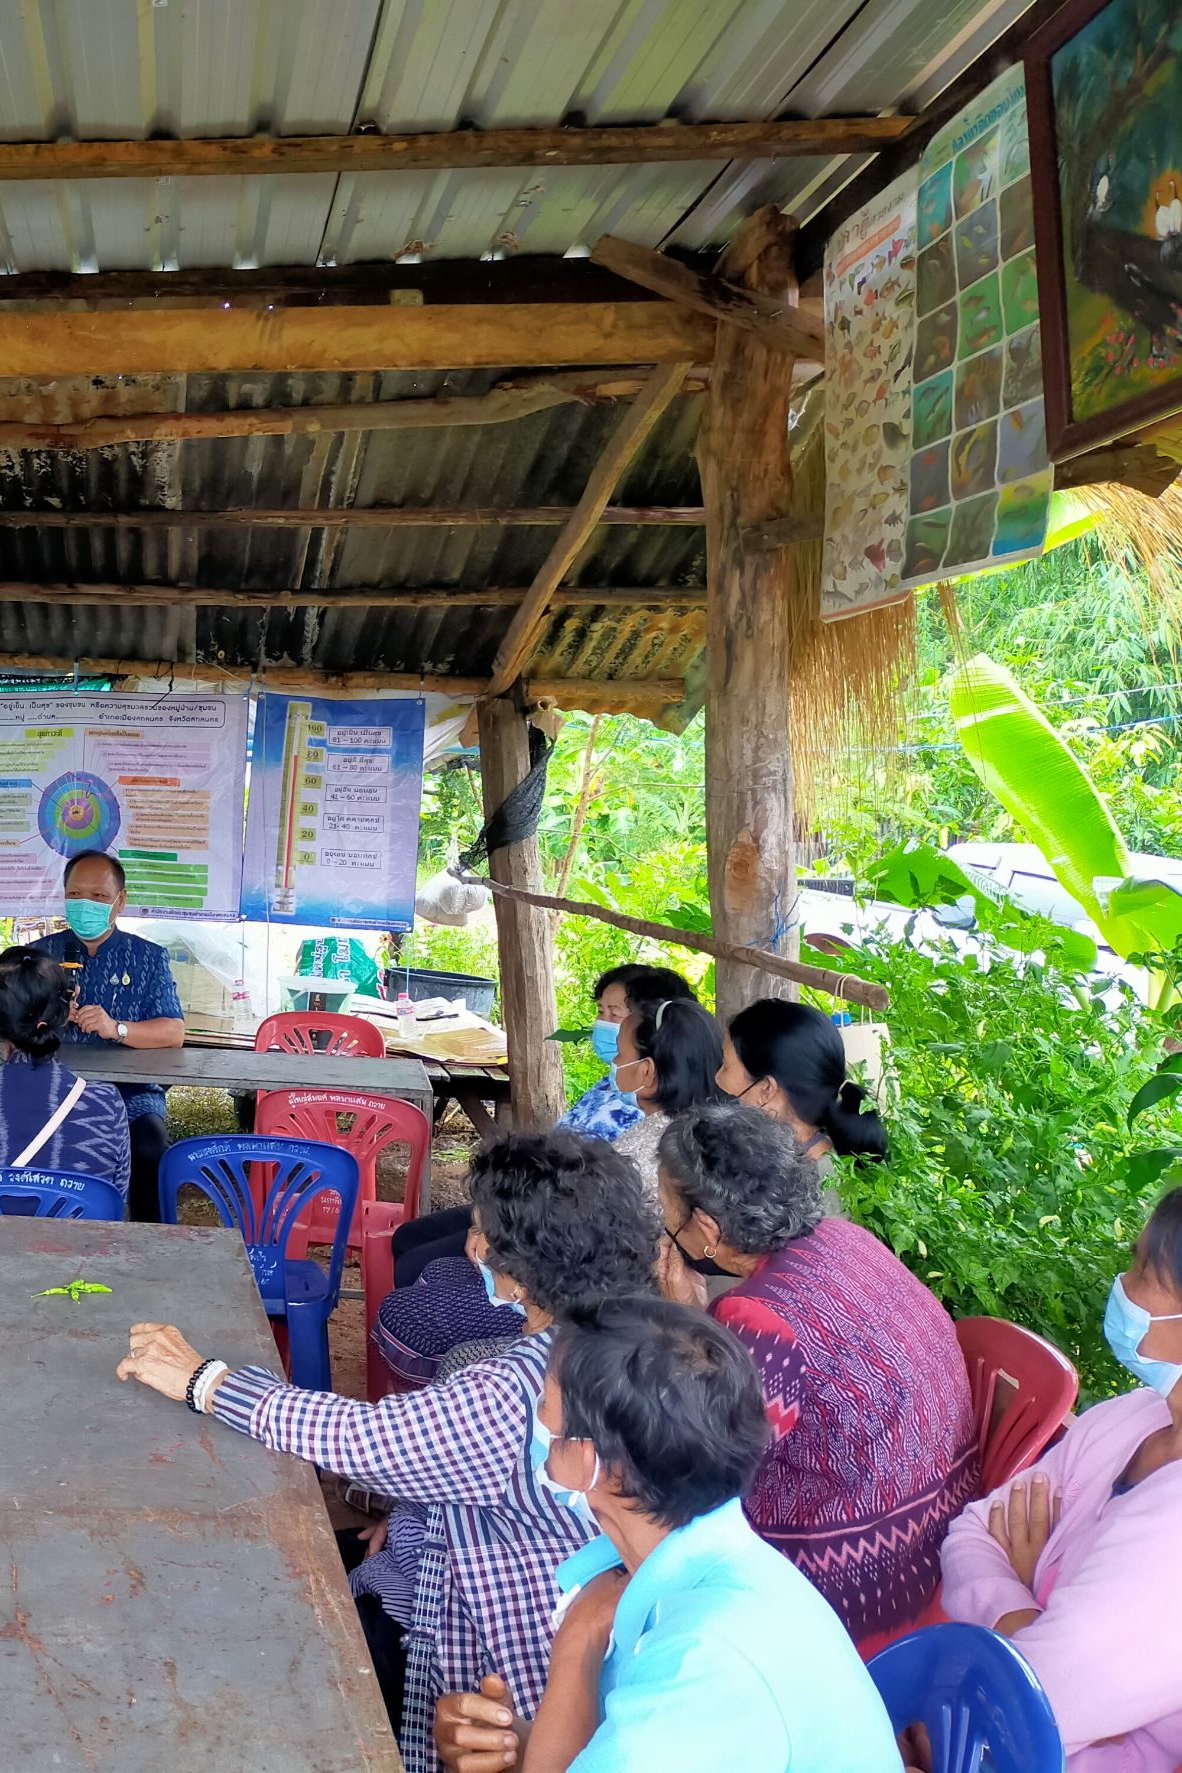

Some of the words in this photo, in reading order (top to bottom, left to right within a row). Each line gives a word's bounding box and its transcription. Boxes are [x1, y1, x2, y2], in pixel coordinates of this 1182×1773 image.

[307, 723, 323, 734] 100
[307, 750, 319, 758] 80
[305, 777, 317, 785] 60
[302, 805, 314, 813] 40
[59, 1178, 86, 1191] ถวาย
